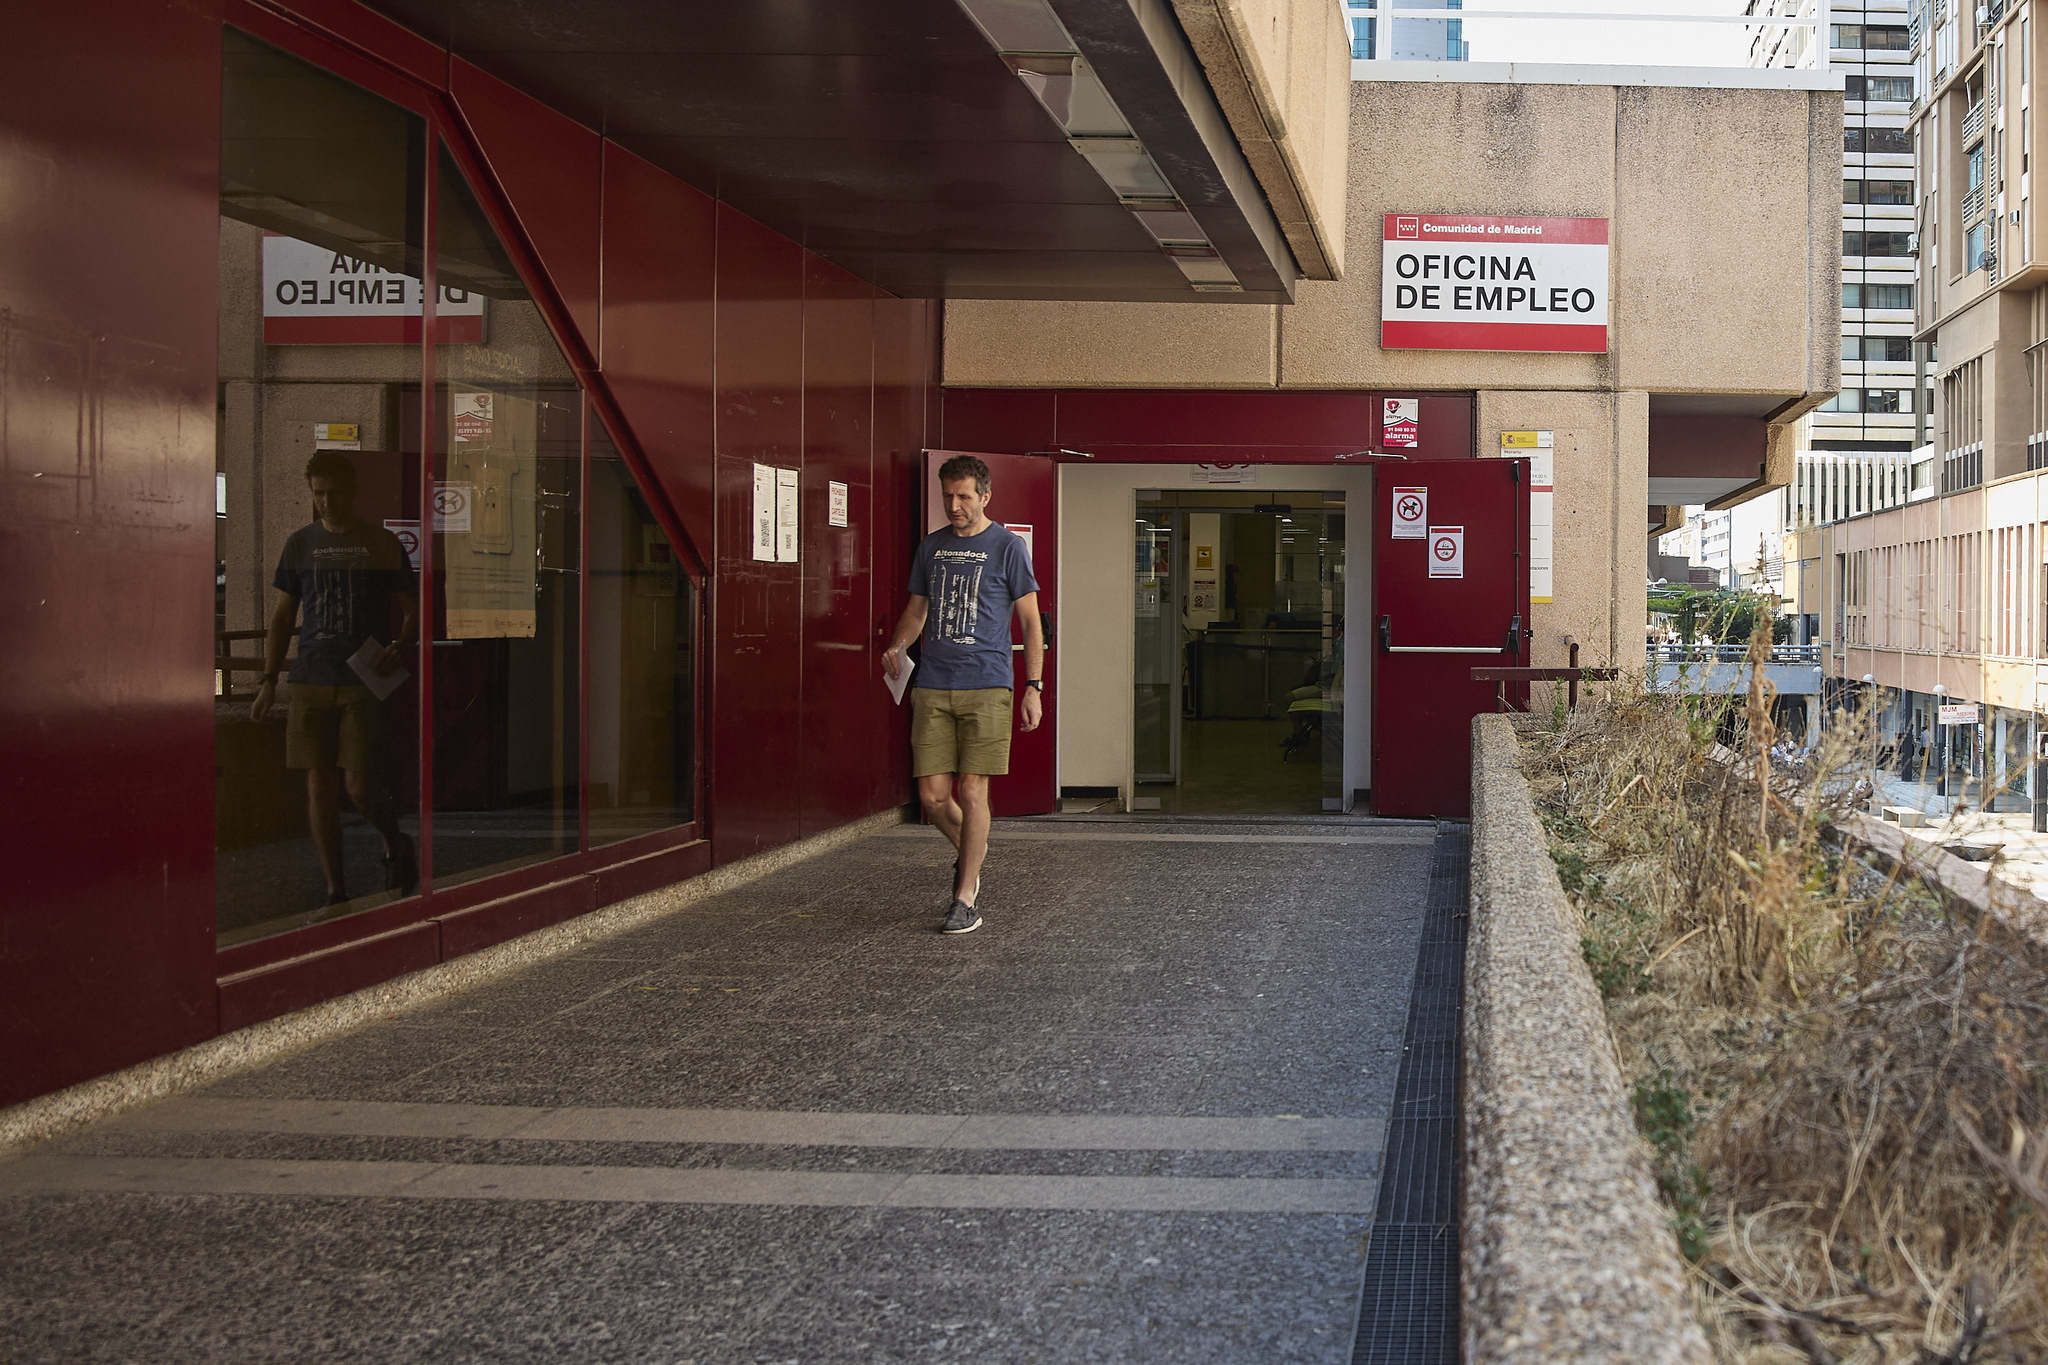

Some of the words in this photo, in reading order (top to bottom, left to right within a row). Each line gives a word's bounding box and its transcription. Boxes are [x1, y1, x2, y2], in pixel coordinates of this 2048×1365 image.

[1423, 223, 1484, 234] Comunidad
[1488, 224, 1501, 234] de
[1504, 224, 1542, 235] Madrid
[1395, 253, 1536, 281] OFICINA
[1396, 285, 1440, 310] DE
[1453, 286, 1595, 313] EMPLEO
[934, 549, 989, 560] Altonadock
